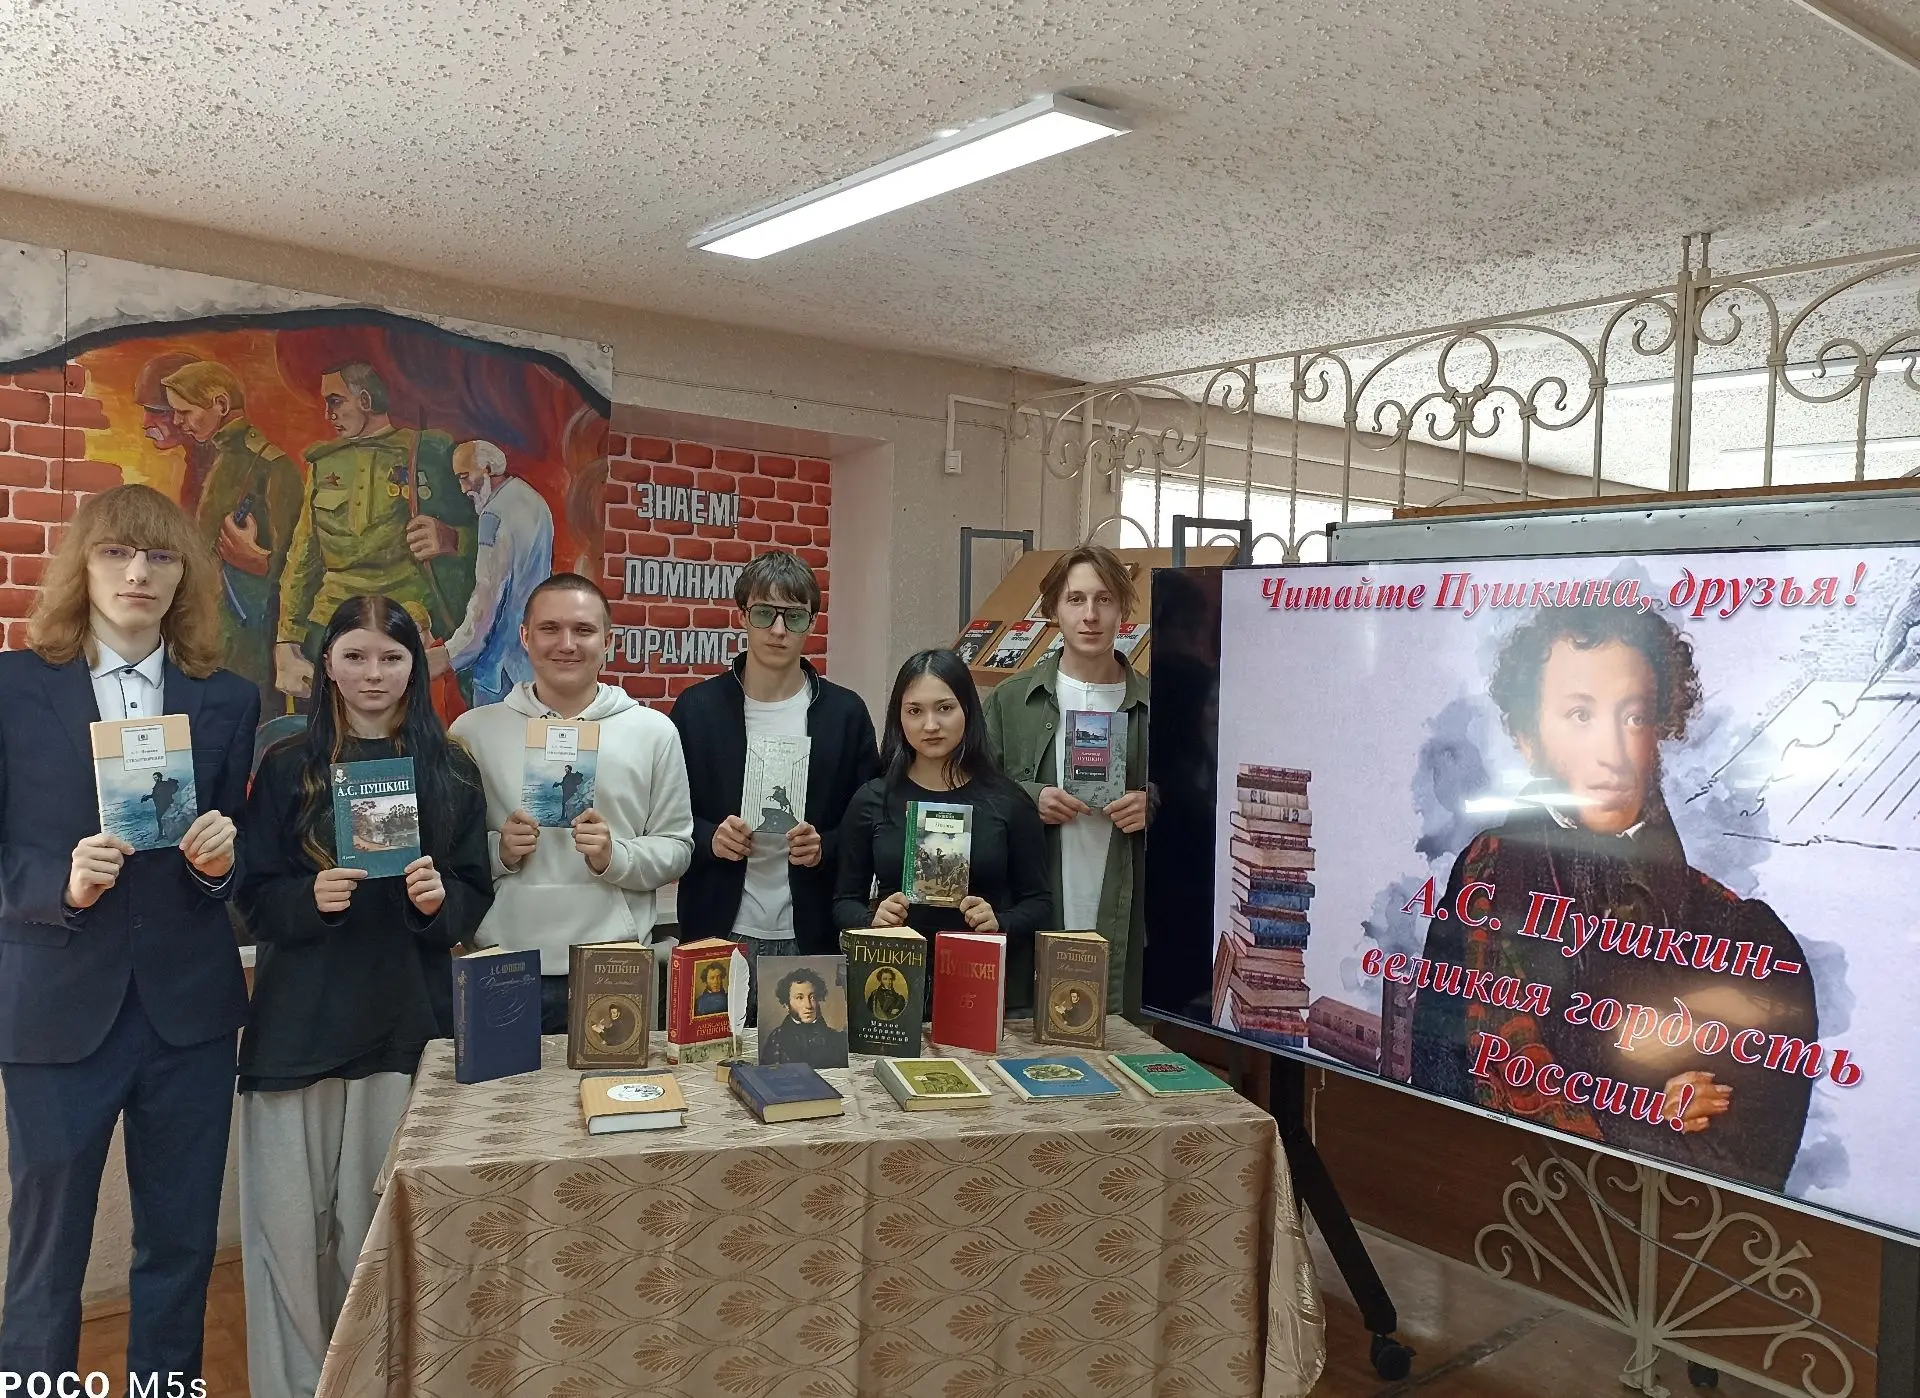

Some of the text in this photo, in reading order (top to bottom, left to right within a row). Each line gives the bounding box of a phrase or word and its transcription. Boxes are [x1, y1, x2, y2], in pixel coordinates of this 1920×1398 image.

[636, 483, 741, 529] ЗНАЕМ!
[624, 557, 745, 600] ПОМНИМ
[1261, 560, 1869, 619] Читайте Пушкина, друзья!
[337, 785, 358, 797] А.С.
[360, 780, 410, 795] ПУШКИН
[1401, 876, 1803, 980] А.С. Пушкин-
[594, 964, 640, 974] ПУШКИН
[1056, 951, 1097, 963] ПУШКИН
[1361, 944, 1864, 1088] великая гордость
[1468, 1031, 1696, 1133] России!
